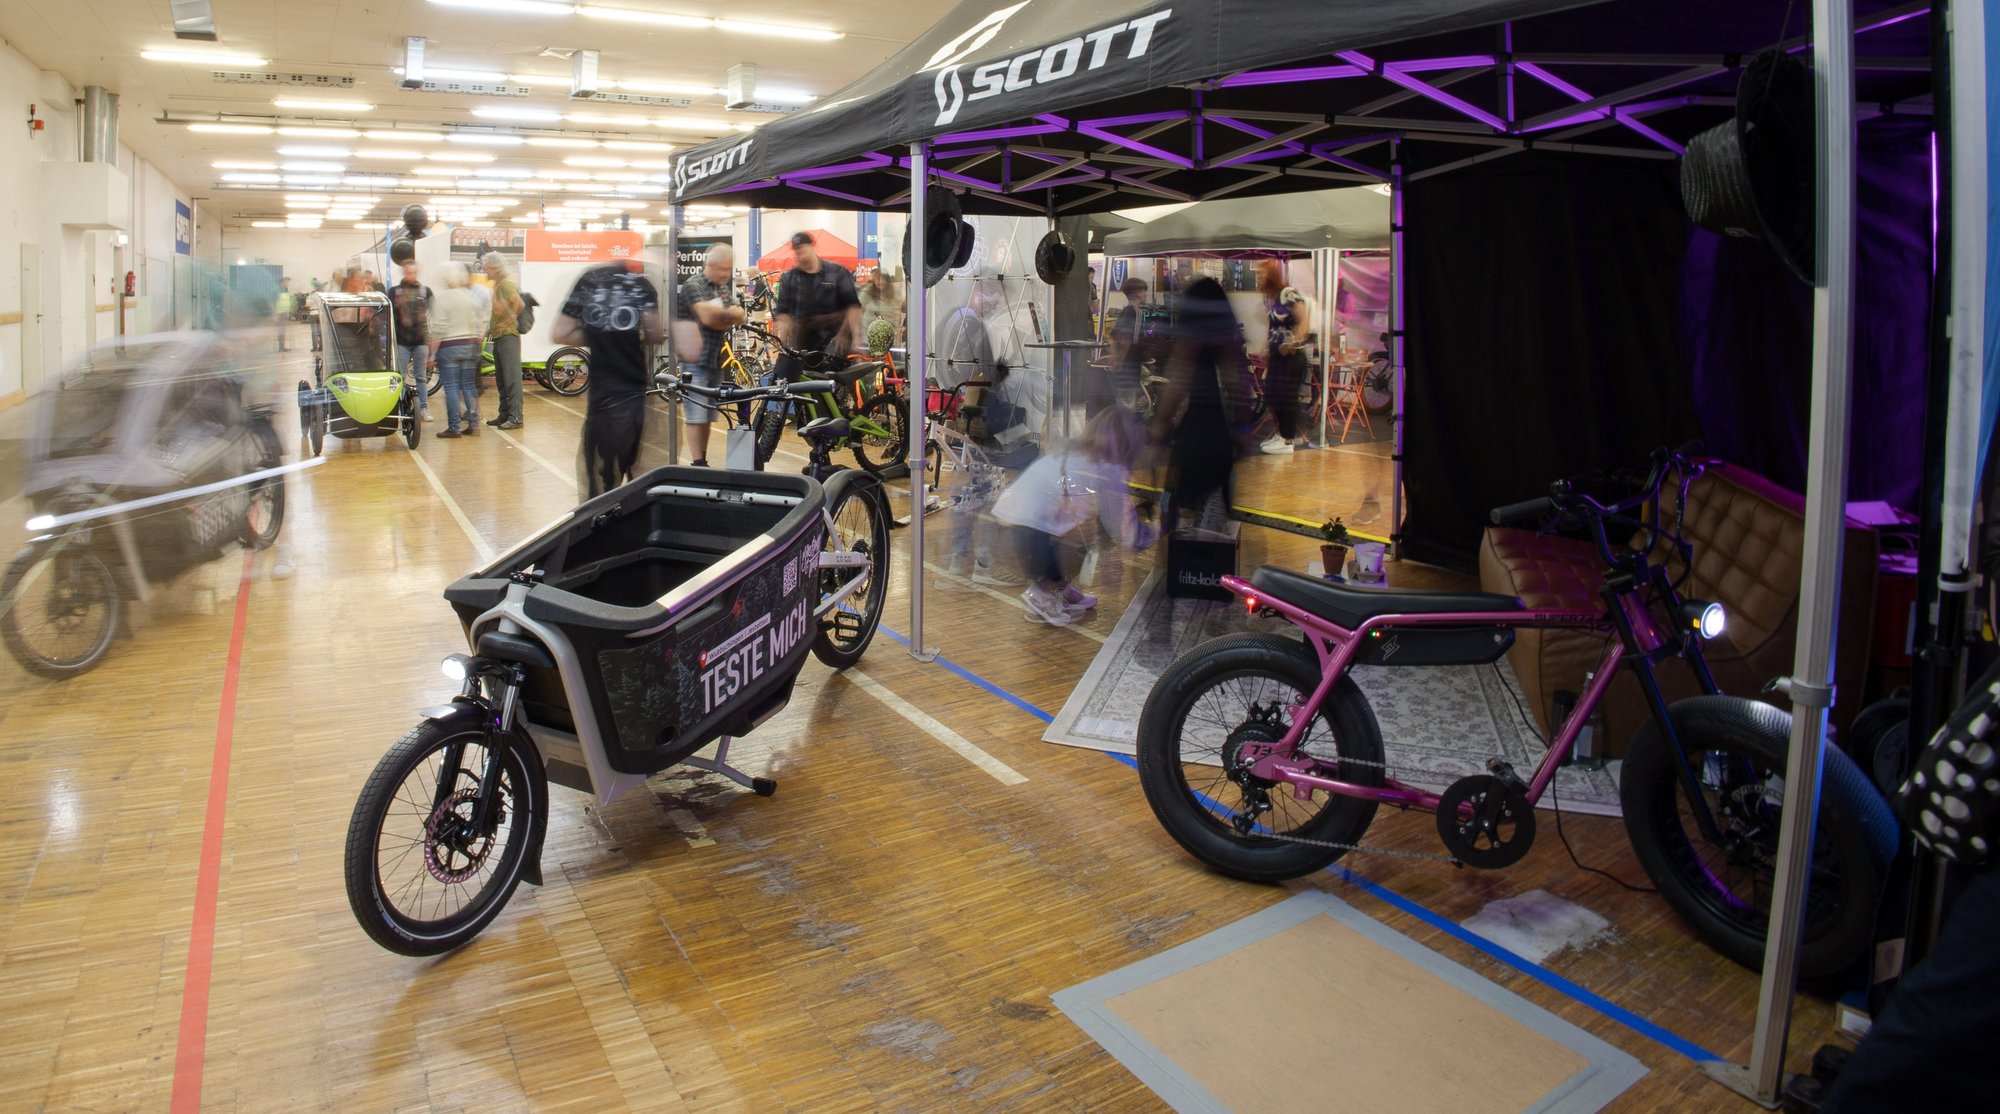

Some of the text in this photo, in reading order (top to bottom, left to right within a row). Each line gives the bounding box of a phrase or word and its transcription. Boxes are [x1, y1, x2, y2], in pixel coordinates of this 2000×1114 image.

[967, 9, 1172, 102] SCOTT
[687, 139, 754, 184] SCOTT
[700, 597, 807, 714] TESTE MICH
